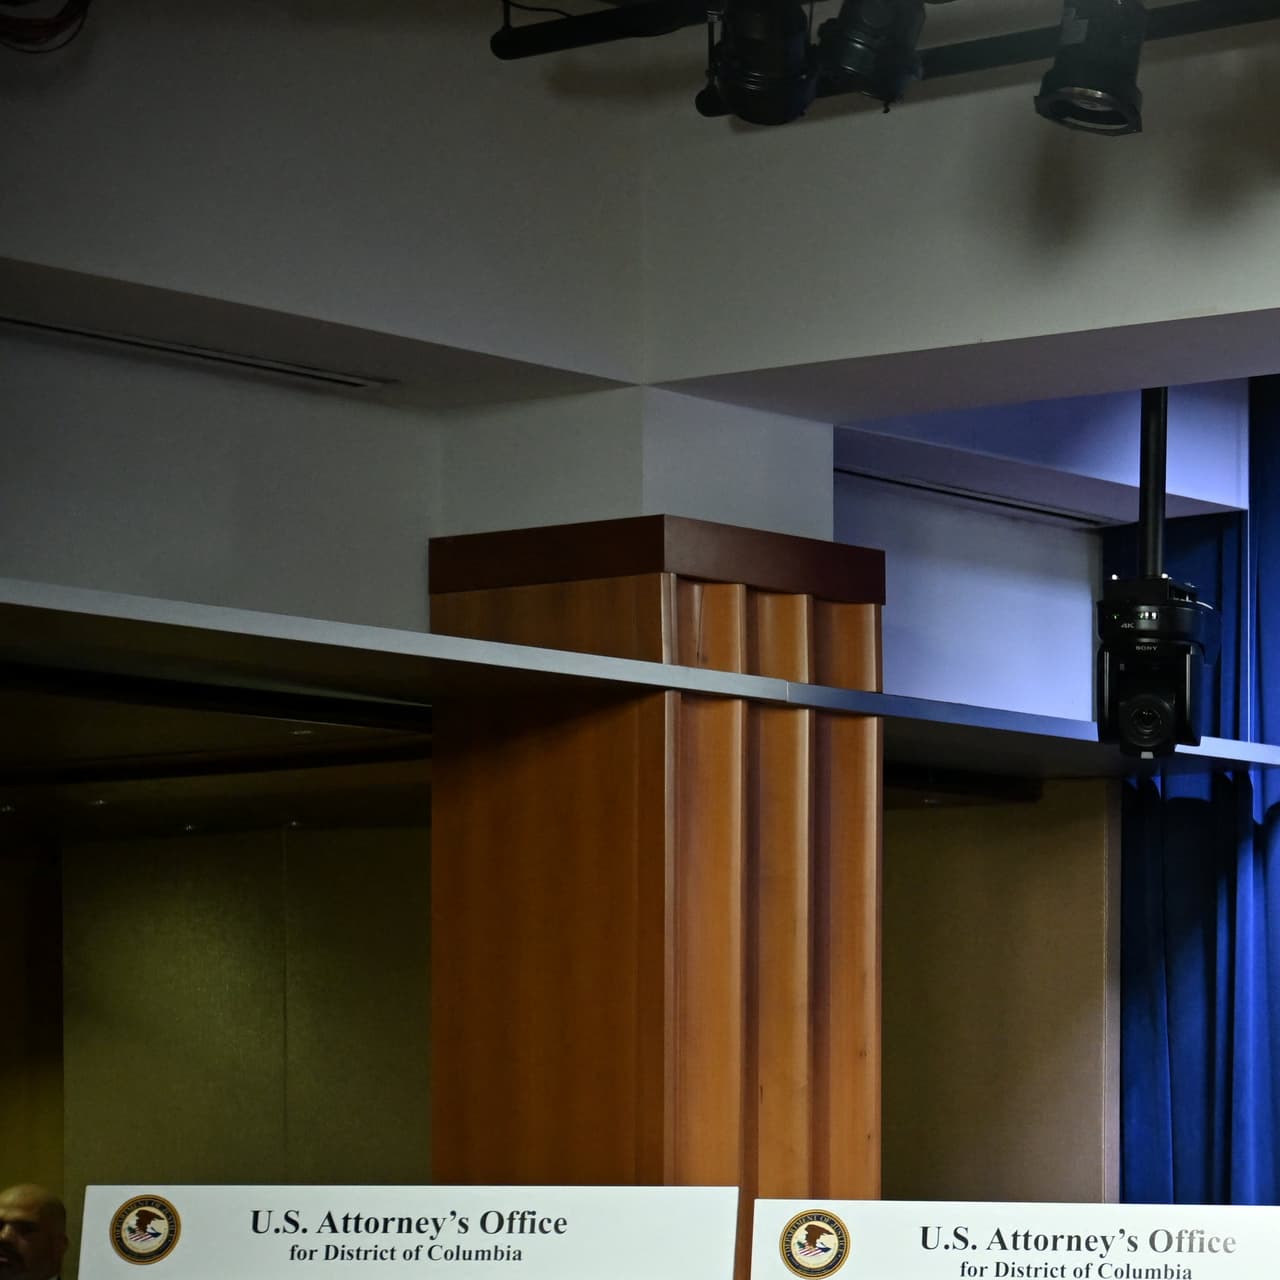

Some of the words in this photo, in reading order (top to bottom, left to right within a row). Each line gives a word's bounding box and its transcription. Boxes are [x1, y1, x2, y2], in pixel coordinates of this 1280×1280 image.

[250, 1210, 308, 1234] U.S.
[316, 1210, 470, 1240] Attorney's
[480, 1210, 568, 1234] Office
[289, 1244, 318, 1261] for
[323, 1244, 396, 1261] District
[402, 1244, 424, 1261] of
[427, 1244, 522, 1261] Columbia
[920, 1226, 978, 1250] U.S.
[986, 1227, 1139, 1258] Attorney's
[1149, 1229, 1237, 1254] Office
[960, 1261, 988, 1278] for
[994, 1261, 1066, 1279] District
[1073, 1262, 1094, 1279] of
[1098, 1262, 1192, 1280] Columbia
